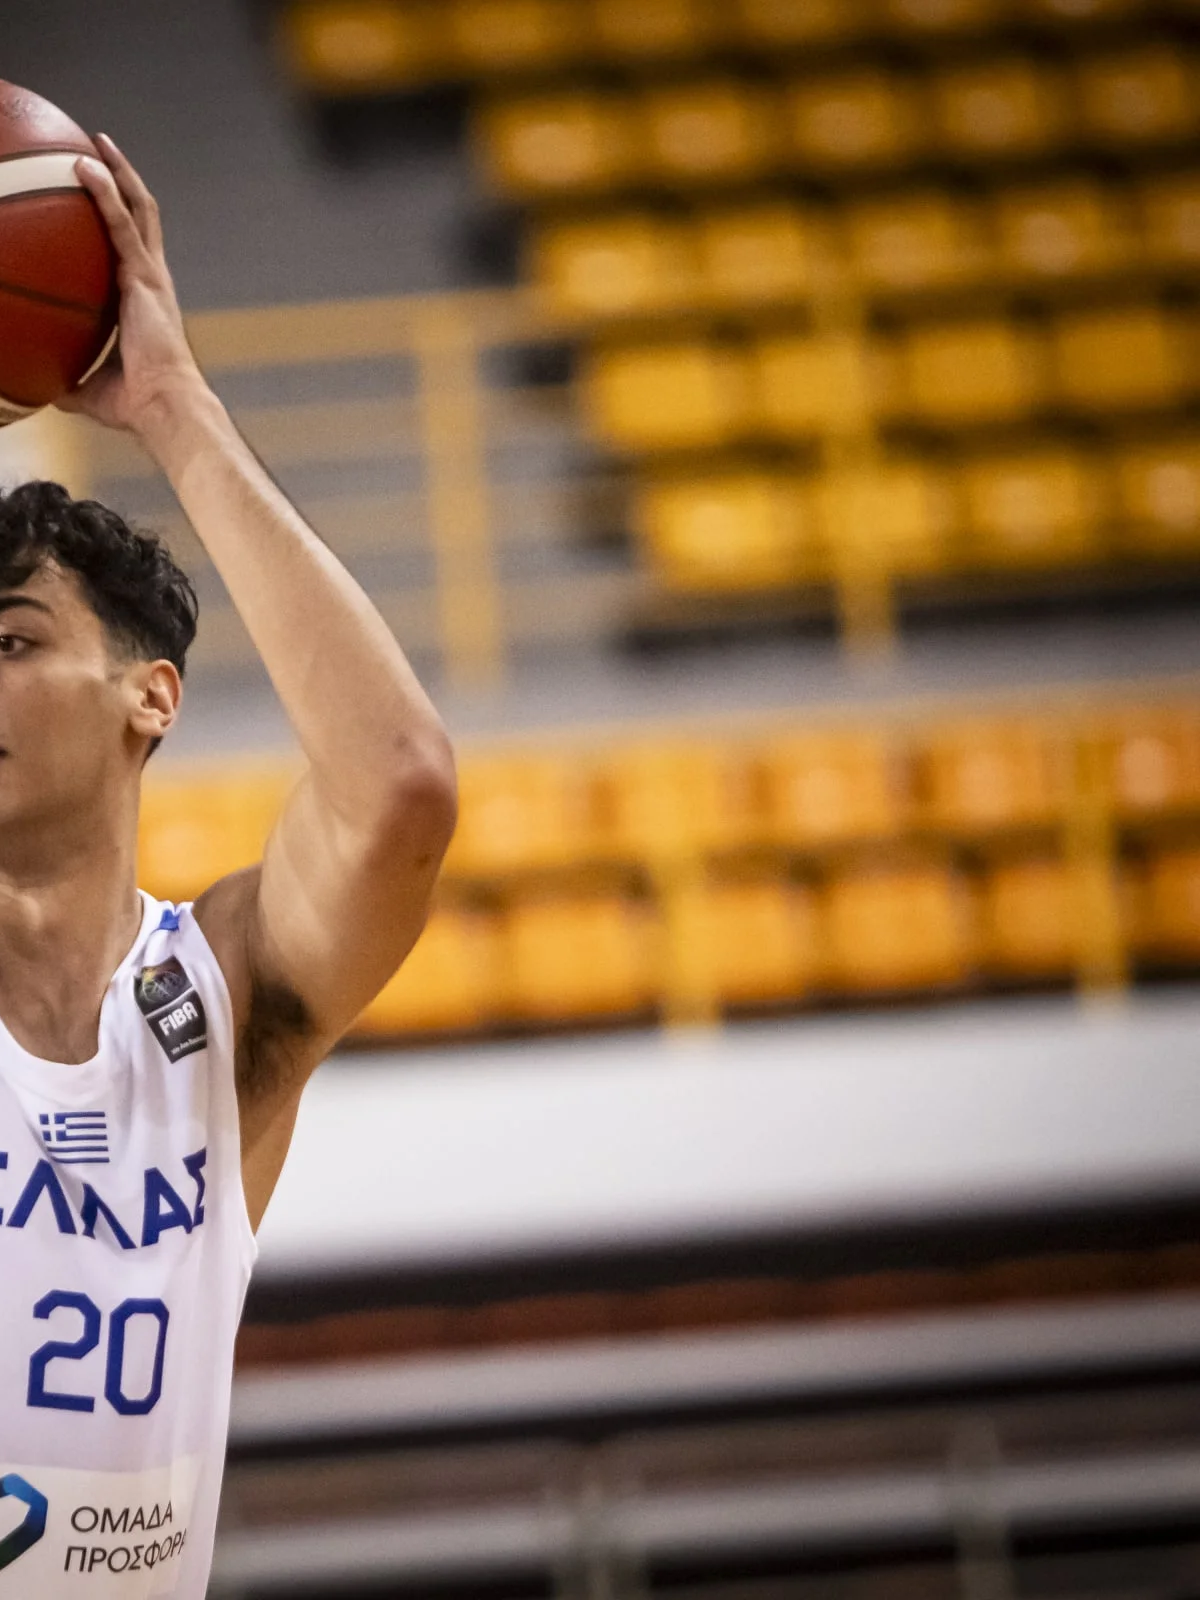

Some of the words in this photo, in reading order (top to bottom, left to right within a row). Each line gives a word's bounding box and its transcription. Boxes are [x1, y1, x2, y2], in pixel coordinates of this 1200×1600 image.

[159, 1001, 198, 1036] FIBA
[27, 1289, 170, 1416] 20
[70, 1500, 173, 1533] ΟΜΑΔΑ
